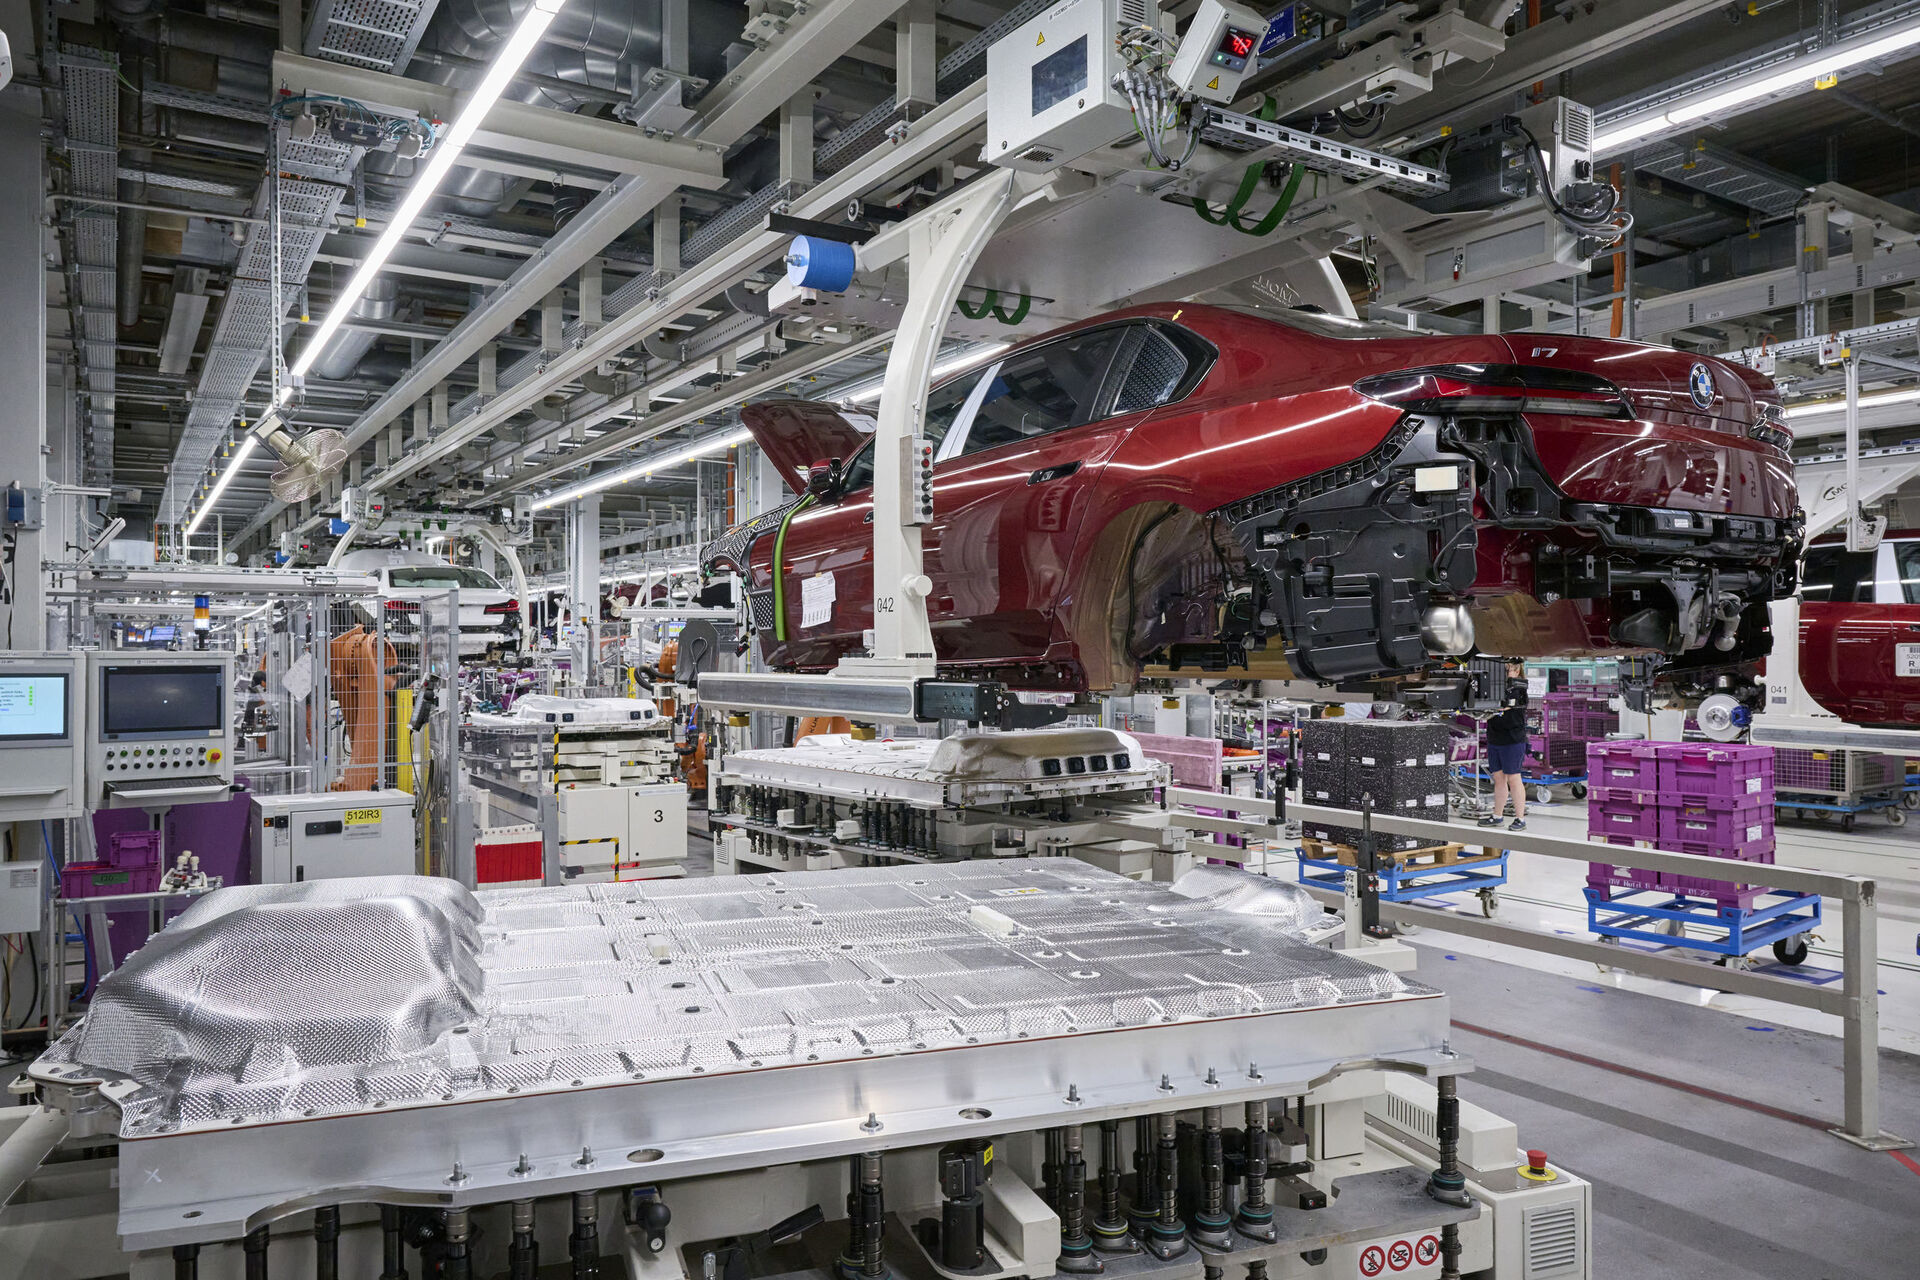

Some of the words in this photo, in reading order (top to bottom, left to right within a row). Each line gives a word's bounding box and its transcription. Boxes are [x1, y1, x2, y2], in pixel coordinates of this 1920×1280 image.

[877, 597, 894, 613] 042
[1770, 685, 1787, 694] 041
[347, 810, 380, 821] 512IR3
[654, 809, 664, 823] 3
